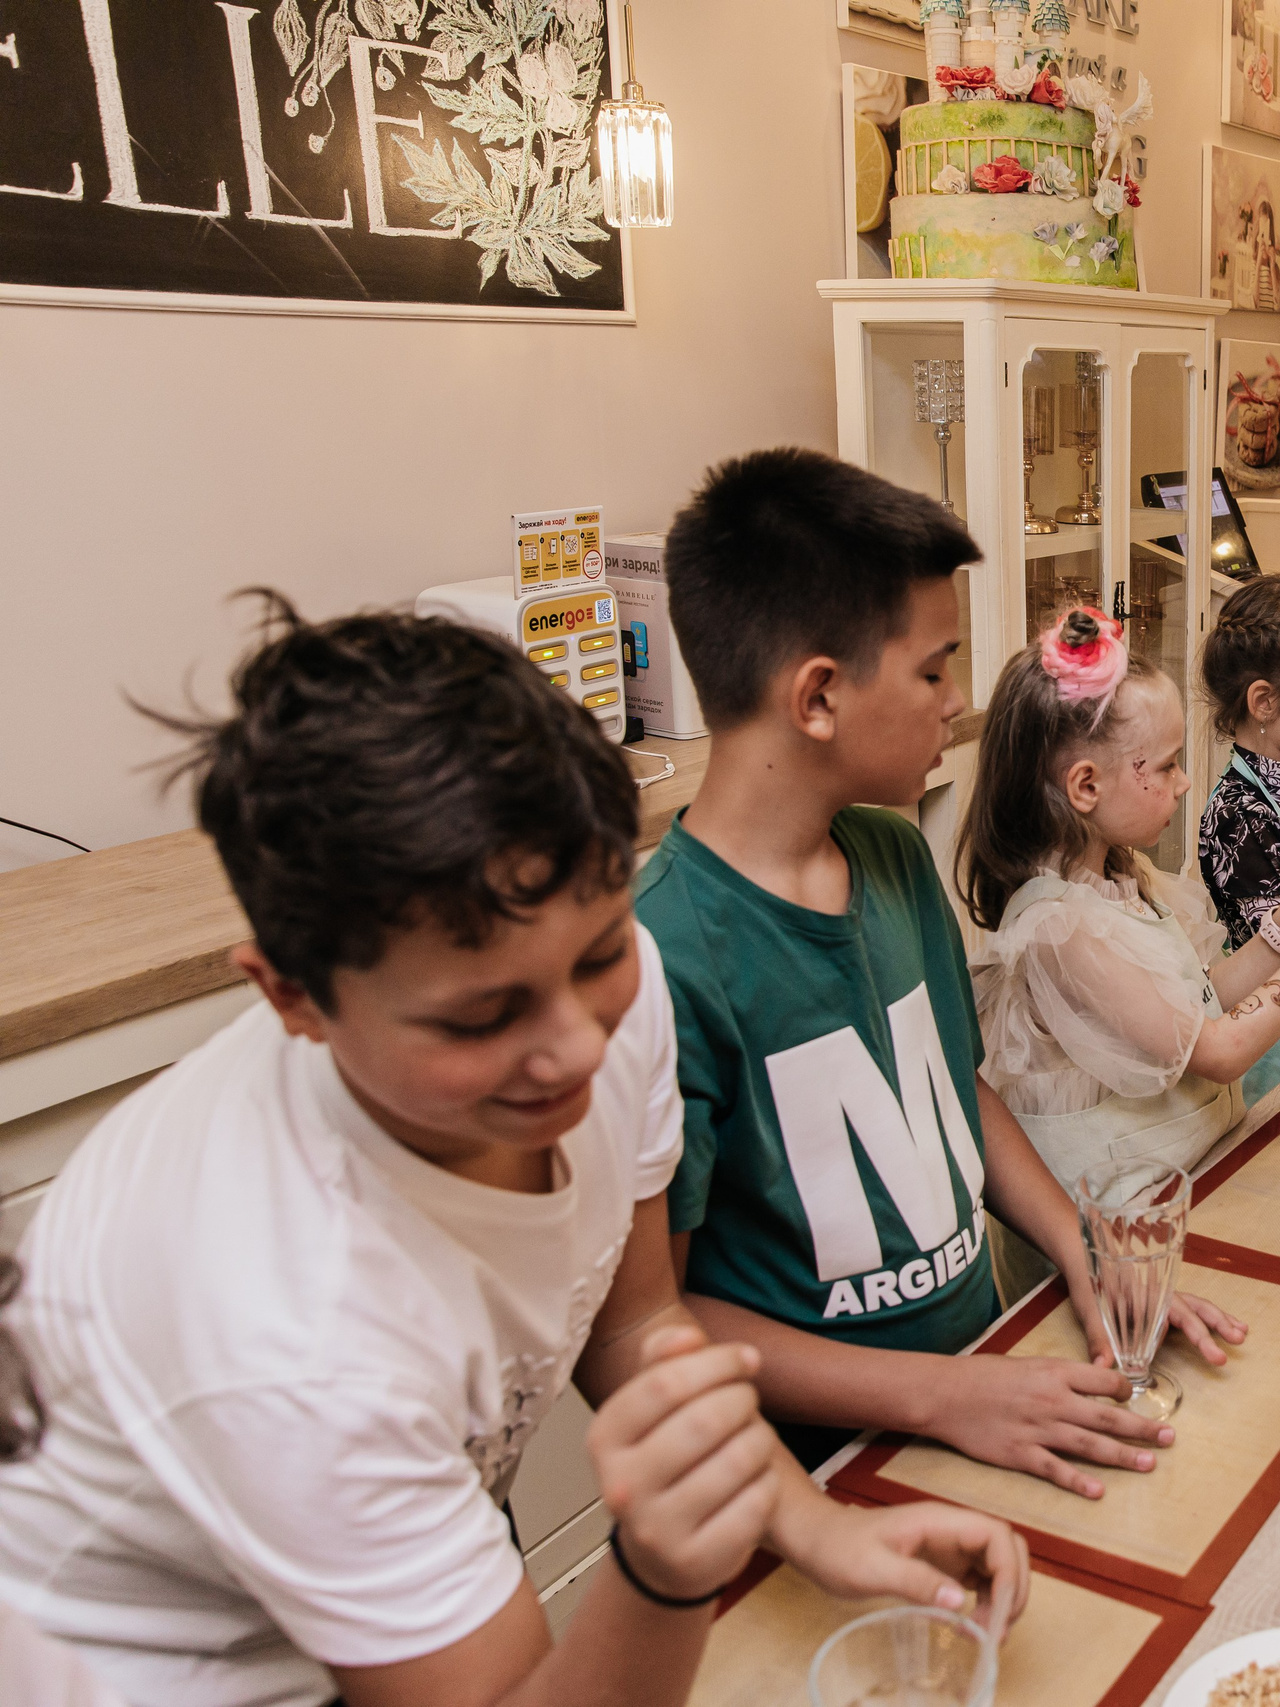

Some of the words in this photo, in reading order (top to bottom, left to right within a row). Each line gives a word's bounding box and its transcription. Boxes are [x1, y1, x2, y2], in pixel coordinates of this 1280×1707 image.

[1066, 0, 1139, 36] KE
[518, 519, 543, 530] Заряжай
[622, 558, 661, 575] заряд!
[529, 608, 585, 632] energo
[642, 698, 664, 707] сервис
[764, 980, 985, 1282] M
